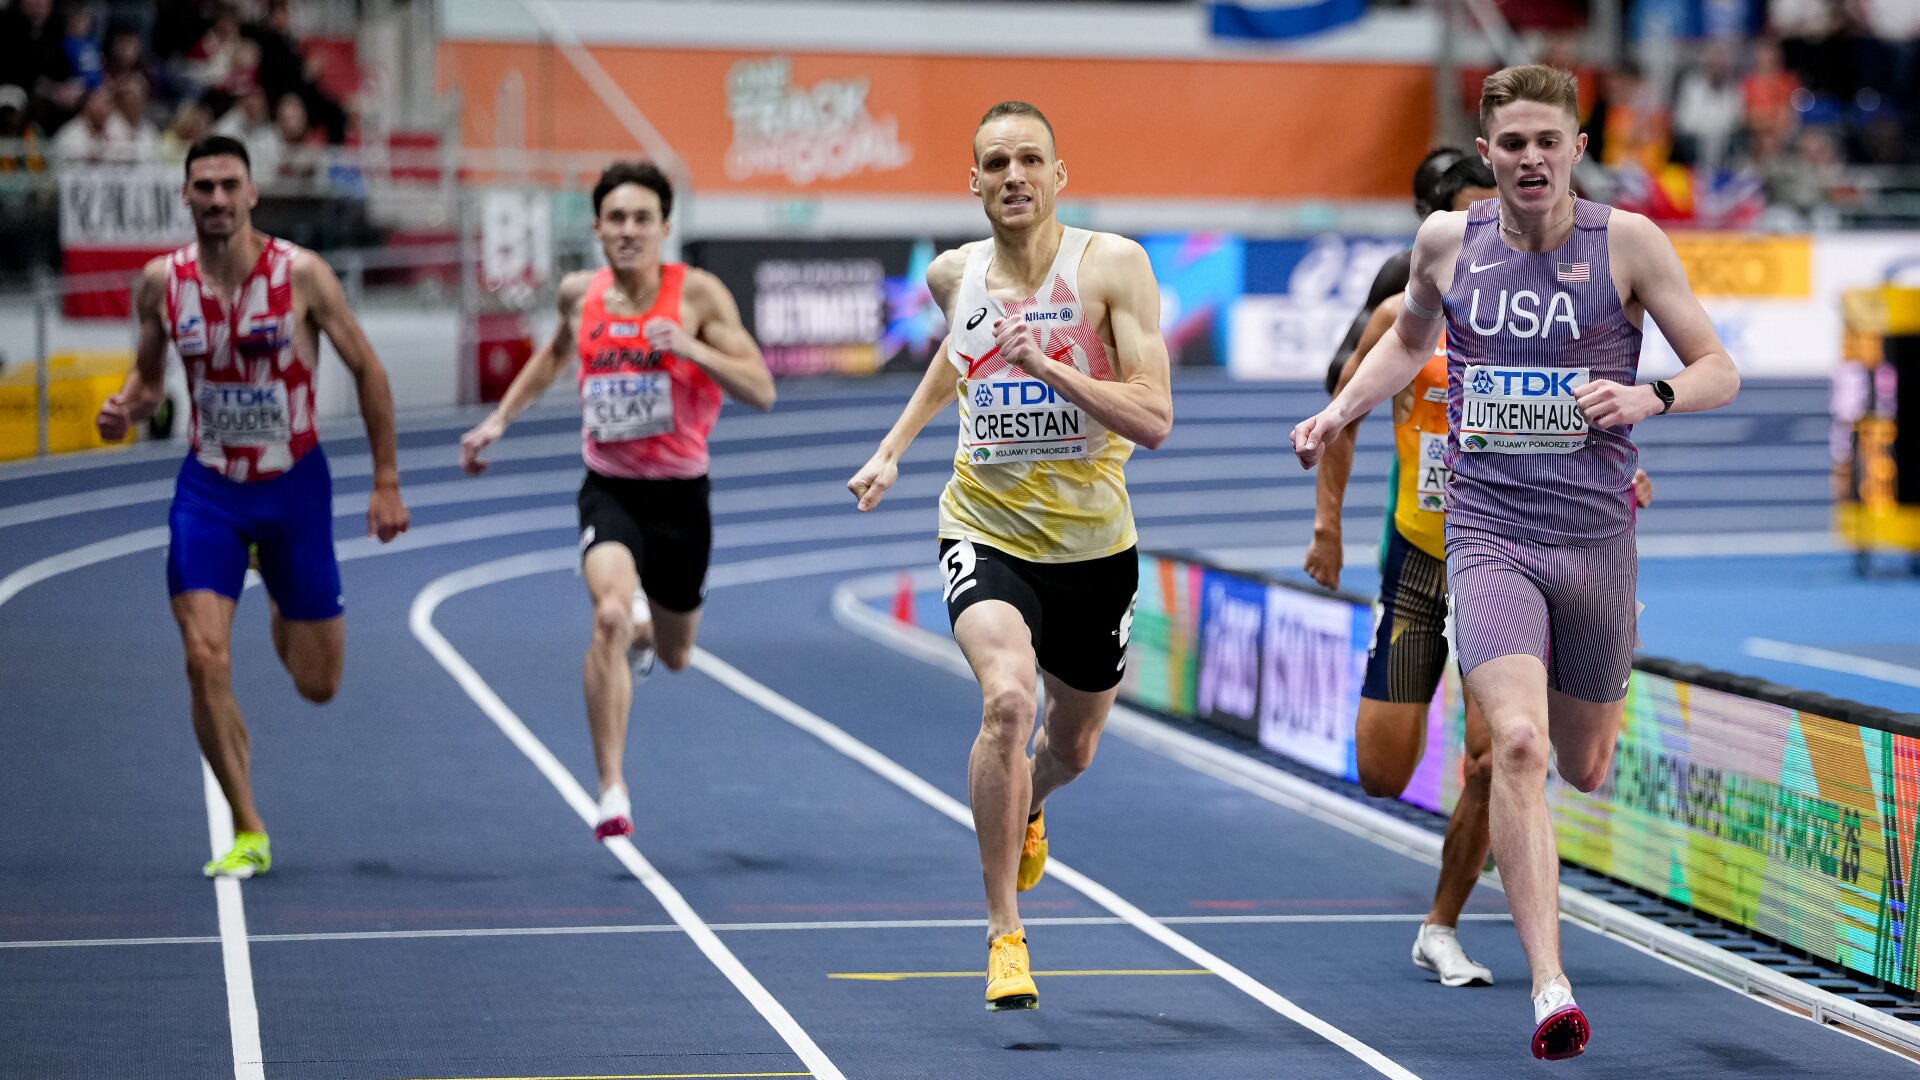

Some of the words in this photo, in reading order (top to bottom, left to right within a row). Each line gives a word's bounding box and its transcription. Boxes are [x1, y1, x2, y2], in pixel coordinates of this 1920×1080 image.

[1025, 311, 1058, 323] Allianz
[1469, 288, 1580, 340] USA
[590, 350, 663, 370] JAPAN
[1493, 371, 1578, 396] TDK
[595, 399, 657, 424] CLAY
[1467, 401, 1583, 431] LUTKENHAUS
[975, 410, 1079, 441] CRESTAN
[996, 448, 1029, 458] KUJAWY
[1030, 446, 1070, 456] POMORZE
[1071, 445, 1082, 454] 26
[1493, 440, 1528, 448] KUJAWY
[1528, 441, 1570, 449] POMORZE
[947, 550, 963, 584] 5
